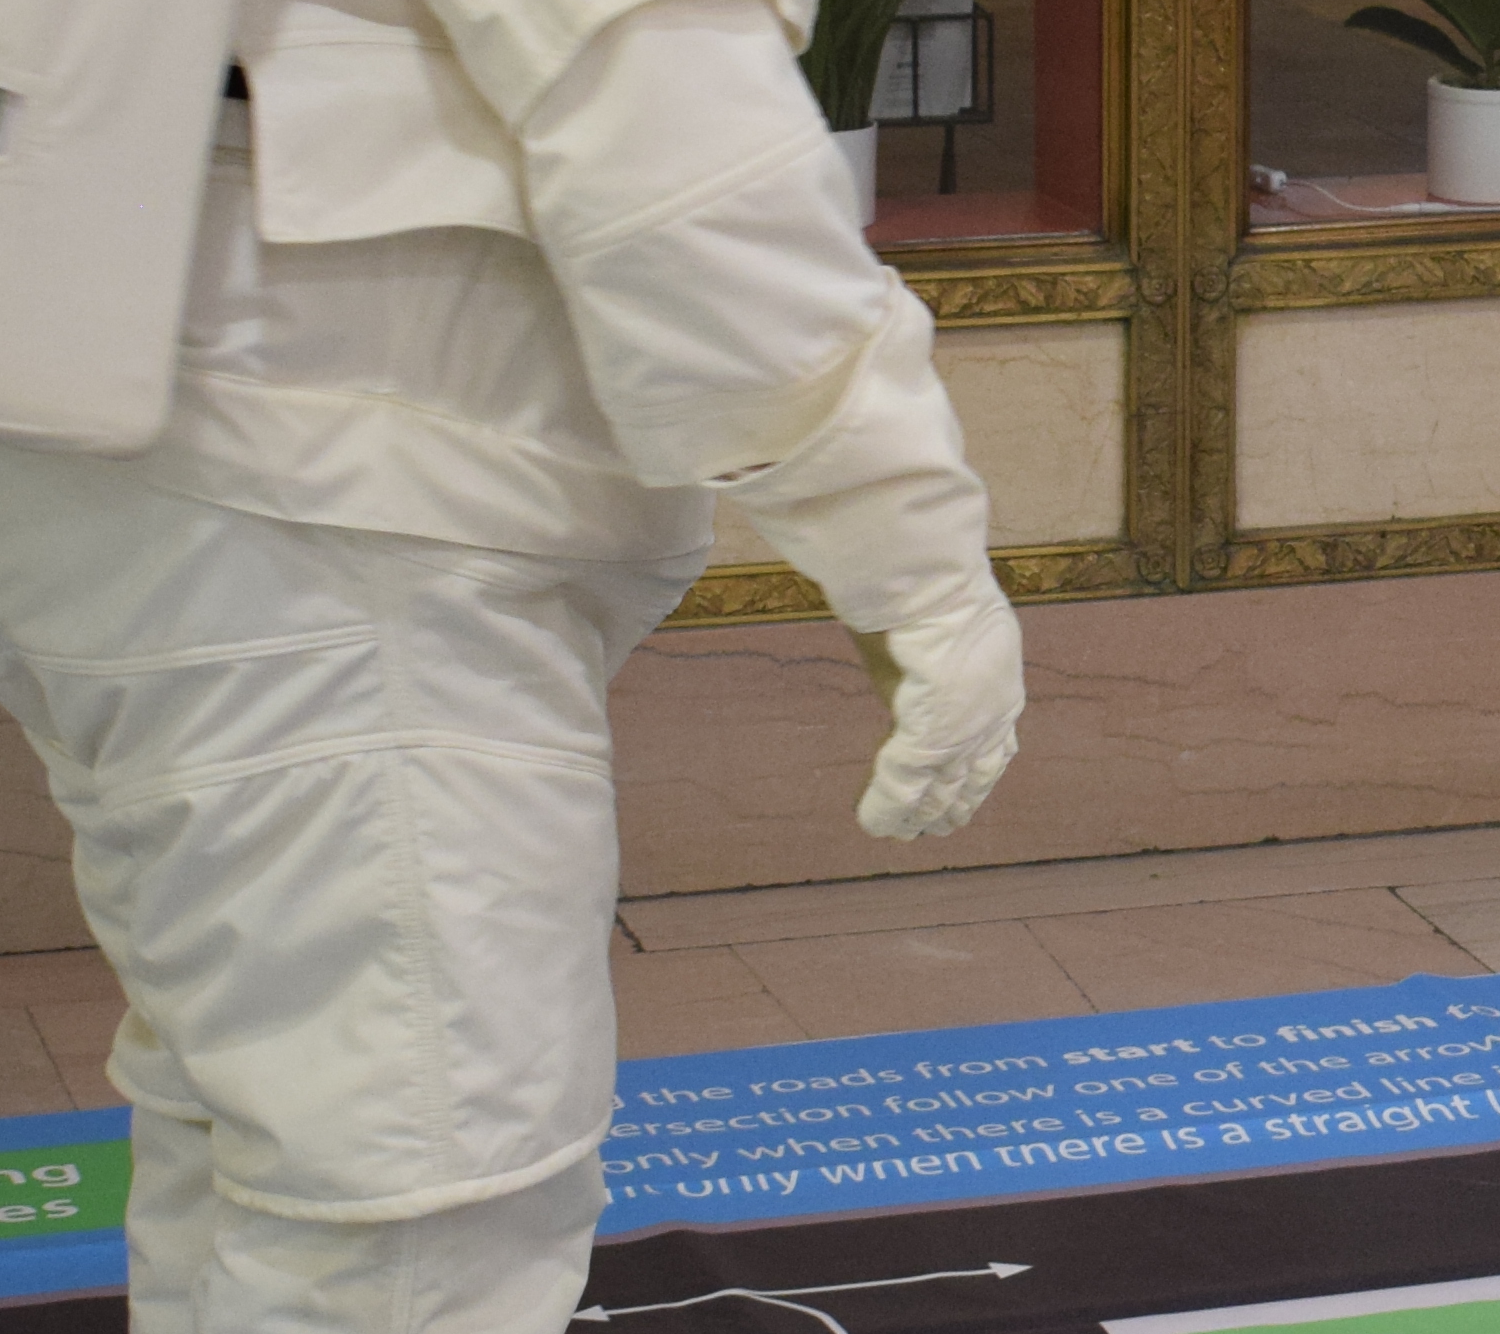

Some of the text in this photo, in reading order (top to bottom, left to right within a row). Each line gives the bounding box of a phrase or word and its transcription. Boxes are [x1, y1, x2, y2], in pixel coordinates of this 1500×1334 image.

[639, 1085, 734, 1106] the
[749, 1067, 904, 1097] roads
[913, 1053, 1048, 1080] from
[1062, 1038, 1201, 1066] start
[1209, 1032, 1267, 1050] to
[1276, 1014, 1439, 1043] finish
[883, 1082, 1055, 1115] follow
[1075, 1072, 1178, 1095] one
[1194, 1062, 1244, 1082] of
[1257, 1055, 1351, 1077] the
[604, 1146, 719, 1174] only
[736, 1131, 901, 1161] when
[911, 1116, 1065, 1144] there
[1075, 1108, 1122, 1127] is
[1137, 1106, 1168, 1121] a
[1182, 1081, 1373, 1116] curved
[1379, 1068, 1485, 1095] line
[1265, 1093, 1479, 1141] straight
